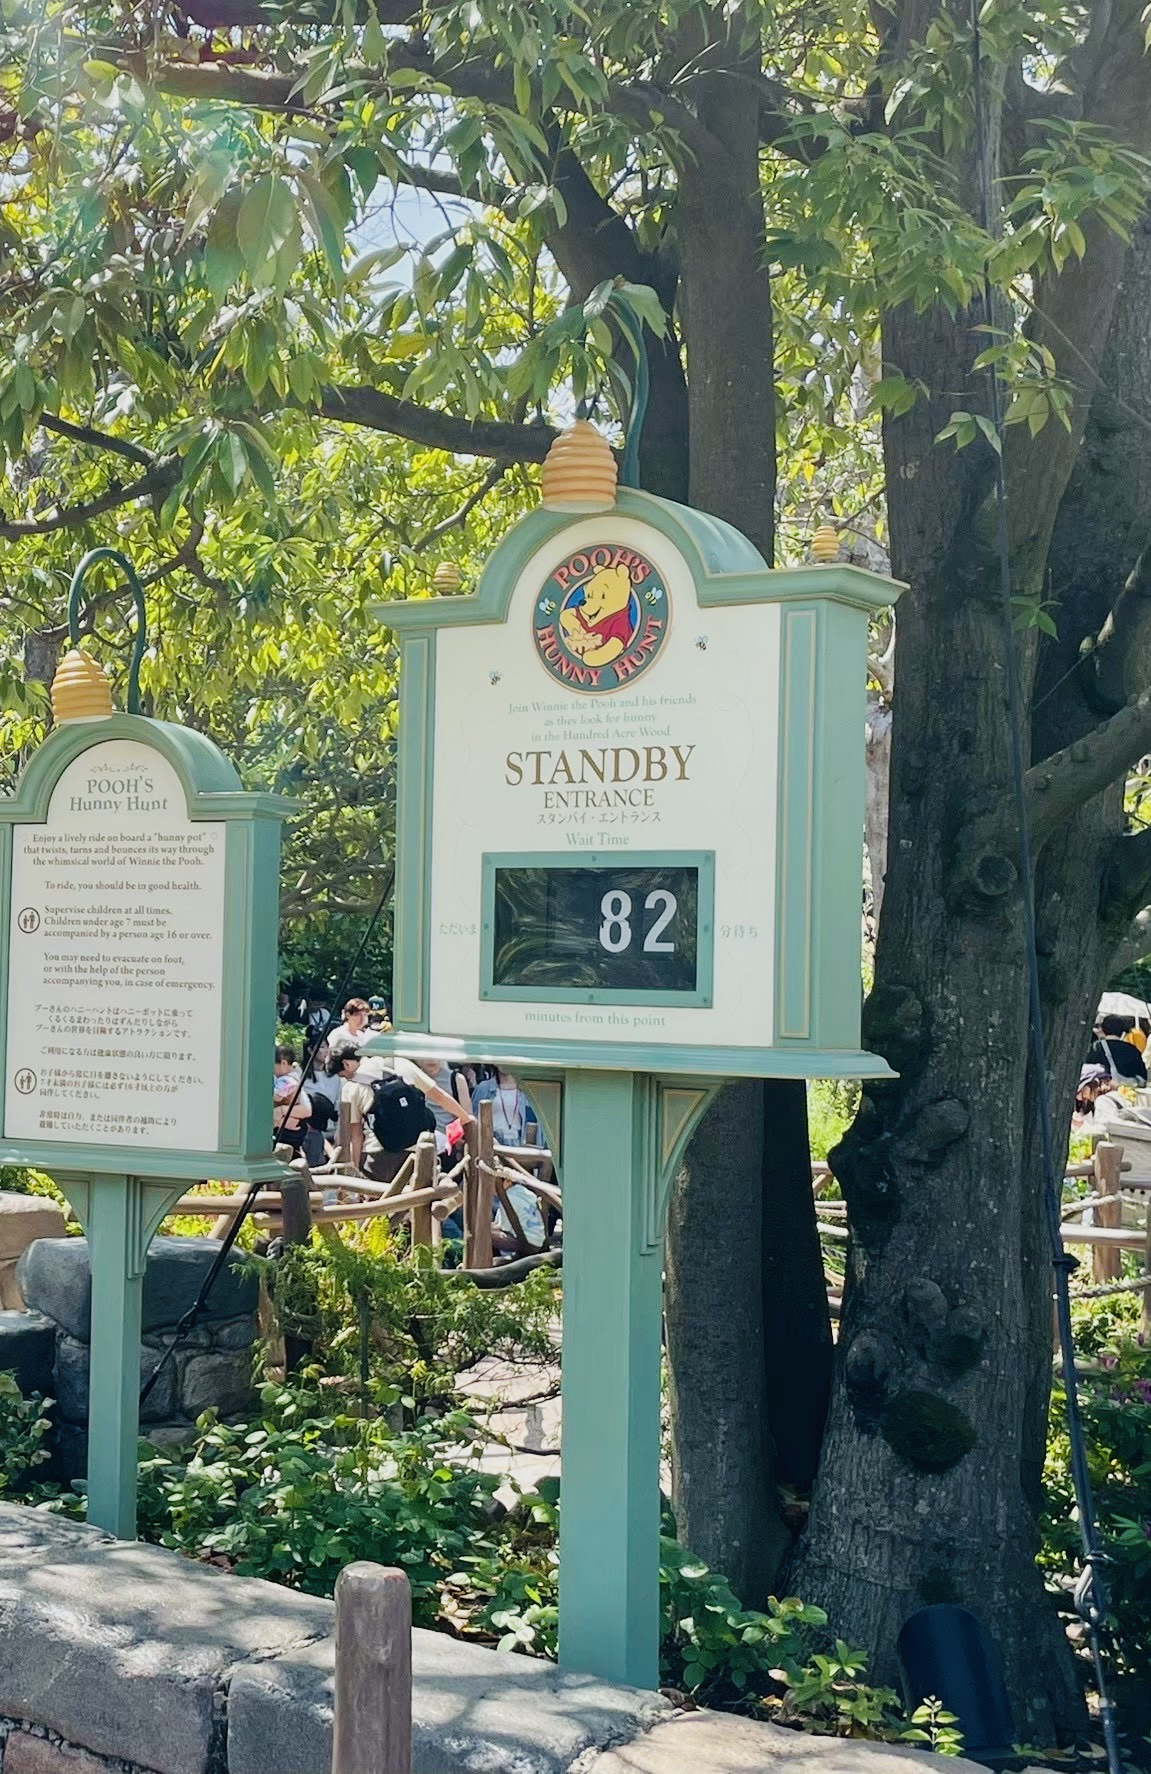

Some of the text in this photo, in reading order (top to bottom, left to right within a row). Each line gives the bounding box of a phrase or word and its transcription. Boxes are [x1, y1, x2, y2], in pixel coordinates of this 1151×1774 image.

[552, 548, 651, 591] POOH'S
[536, 615, 662, 686] HUNNY HUNT
[508, 694, 697, 715] Join Winnie the Pooh and his friends
[544, 712, 656, 728] as they look for hunny
[531, 726, 670, 742] in the Hundred Acre Wood
[505, 744, 696, 787] STANDBY
[87, 775, 154, 794] POOH'S
[69, 796, 168, 813] Hunny Hunt
[544, 788, 655, 809] ENTRANCE
[32, 834, 57, 845] Enjoy
[64, 833, 87, 844] lively
[89, 833, 105, 842] ride
[120, 833, 145, 842] board
[565, 832, 630, 846] Wait Time
[23, 846, 40, 854] that
[70, 846, 92, 854] turns
[94, 845, 110, 854] and
[111, 845, 146, 854] bounces
[148, 846, 159, 854] its
[160, 847, 177, 855] way
[179, 845, 214, 856] through
[33, 857, 204, 866] the whimsical world of Winnie the Pooh.
[45, 881, 202, 892] To ride, you should be in good health.
[44, 906, 85, 916] Supervise
[87, 906, 123, 915] children
[134, 906, 144, 915] all
[146, 906, 172, 915] times.
[44, 917, 81, 926] Children
[83, 917, 108, 926] under
[109, 920, 124, 928] age
[133, 919, 154, 927] must
[156, 918, 167, 927] be
[598, 888, 678, 953] 82
[44, 929, 99, 939] accompanied
[100, 930, 112, 940] by
[119, 932, 148, 940] person
[149, 932, 165, 941] age
[167, 930, 177, 939] 16
[179, 932, 189, 940] or
[191, 932, 212, 940] over.
[439, 922, 478, 935] ただいま
[720, 925, 758, 939] 分待ち
[43, 953, 60, 961] You
[61, 954, 78, 964] may
[80, 953, 100, 962] need
[102, 954, 111, 962] to
[112, 955, 149, 963] evacuate
[164, 954, 185, 965] foot,
[54, 965, 73, 973] with
[75, 965, 88, 973] the
[89, 965, 108, 975] help
[109, 966, 119, 974] of
[120, 966, 134, 974] the
[135, 968, 165, 977] person
[43, 977, 103, 988] accompanying
[124, 978, 133, 987] in
[155, 979, 164, 987] of
[166, 981, 215, 990] emergency.
[525, 1011, 666, 1027] minutes from this point
